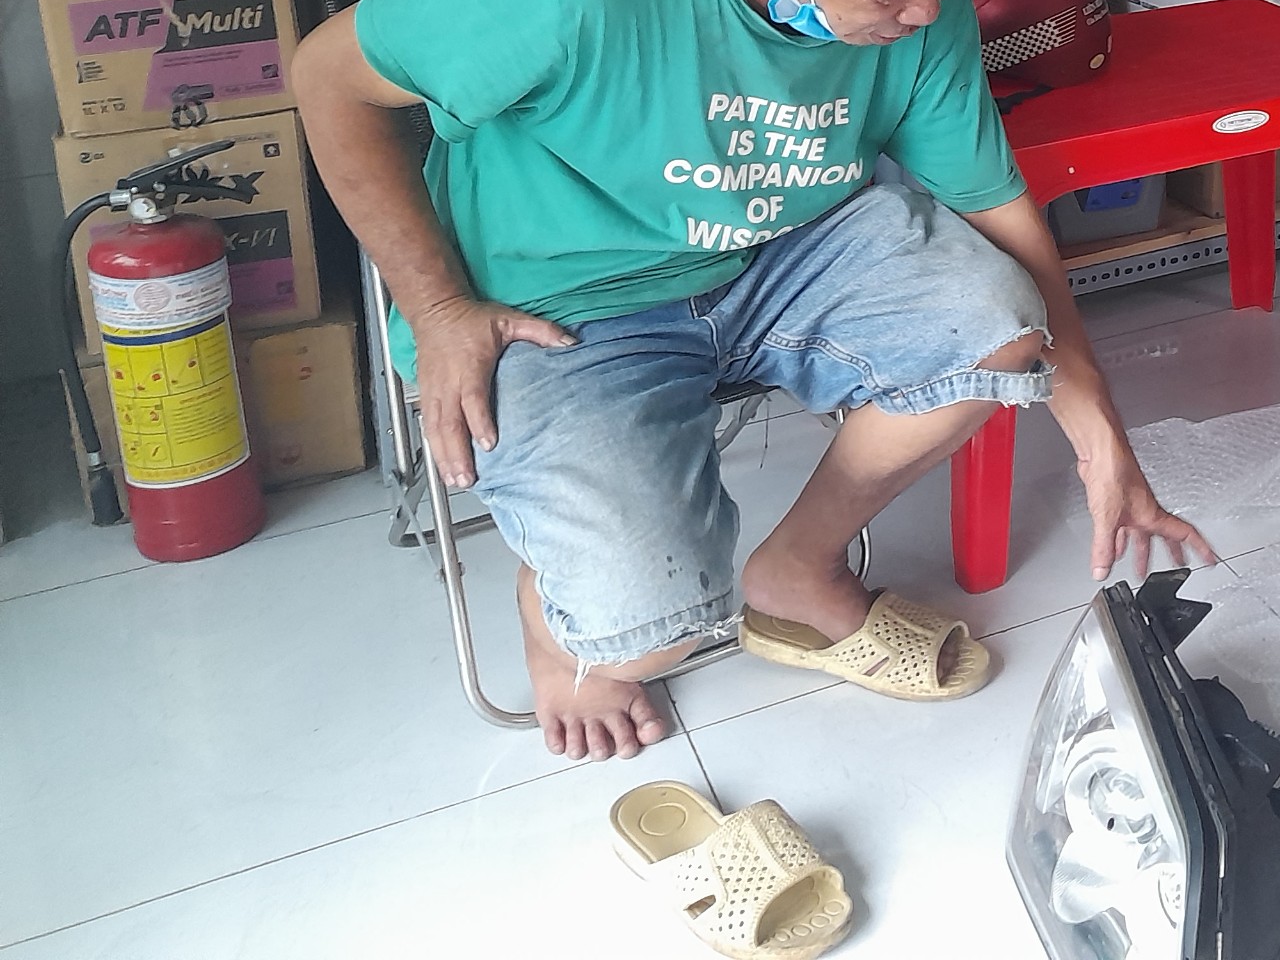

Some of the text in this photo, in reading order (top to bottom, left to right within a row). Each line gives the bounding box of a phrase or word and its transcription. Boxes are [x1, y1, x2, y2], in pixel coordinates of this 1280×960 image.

[83, 3, 264, 43] ATF Multi
[707, 93, 850, 131] PATIENCE
[727, 130, 828, 162] IS THE
[663, 158, 864, 192] COMPANION
[746, 195, 785, 225] OF
